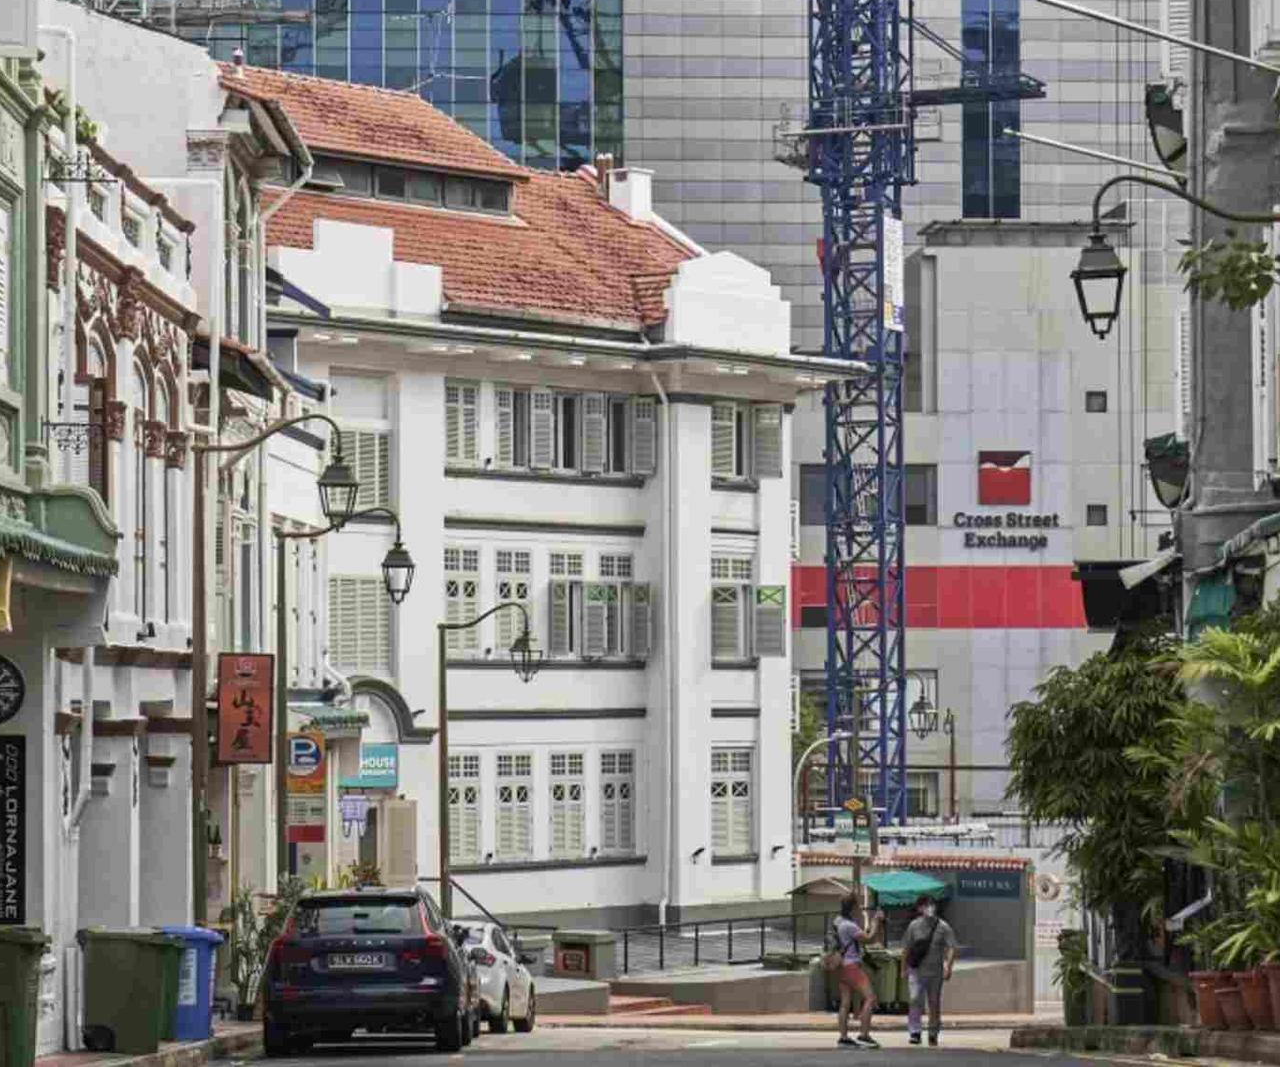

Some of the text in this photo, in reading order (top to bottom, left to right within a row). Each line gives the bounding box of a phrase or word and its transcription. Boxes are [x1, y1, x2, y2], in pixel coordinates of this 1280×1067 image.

[953, 512, 1059, 528] Cross Street
[964, 531, 1048, 552] Exchange
